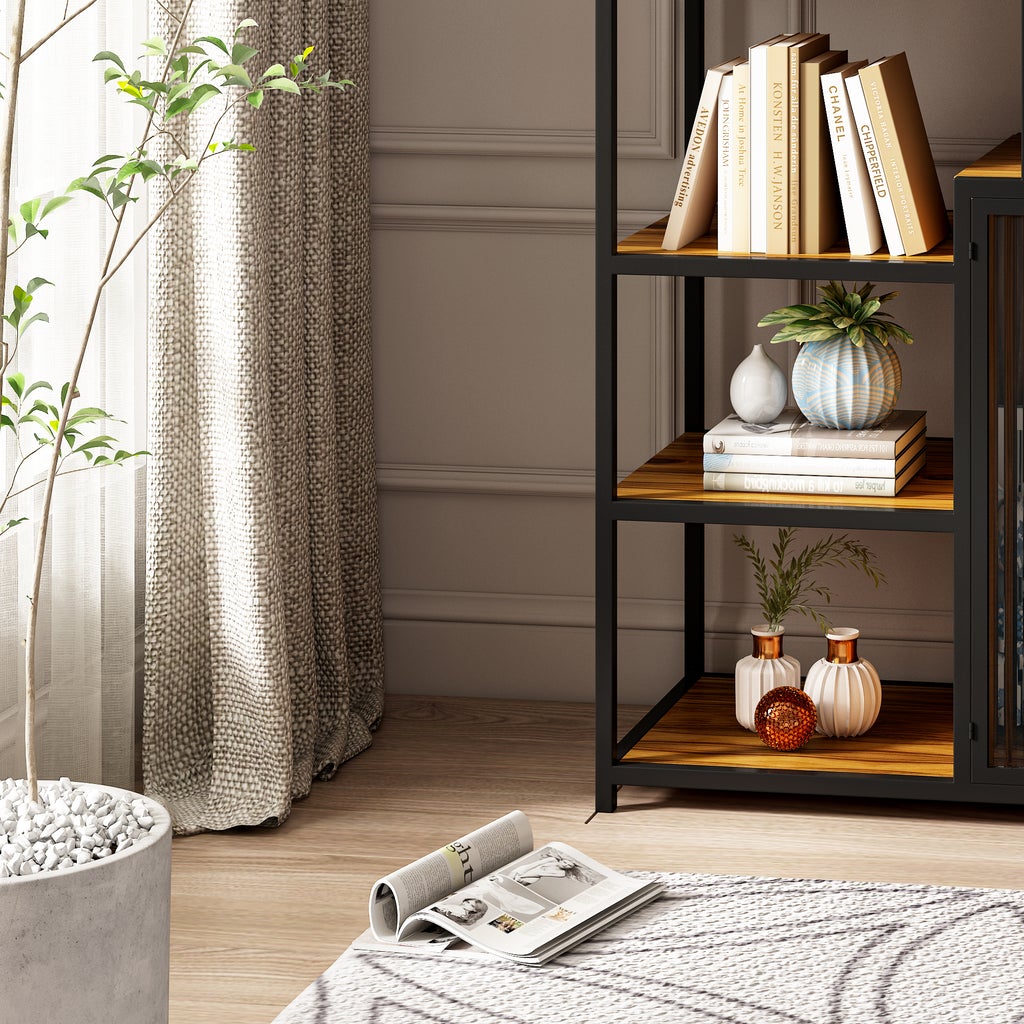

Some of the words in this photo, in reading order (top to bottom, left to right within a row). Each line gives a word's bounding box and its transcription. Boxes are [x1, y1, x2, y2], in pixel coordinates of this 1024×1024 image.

[738, 85, 746, 94] At
[738, 97, 746, 122] Home
[773, 82, 782, 141] KONSTEN
[828, 85, 846, 142] CHANEL
[691, 106, 709, 153] AVEDON
[737, 136, 746, 165] Joshua
[674, 154, 696, 208] advertising
[738, 168, 746, 187] Tree
[860, 124, 887, 198] CHIPPERFIELD
[870, 81, 884, 120] VICTORIA
[879, 122, 892, 149] HAGAN
[890, 157, 904, 193] INTERIOR
[899, 194, 914, 235] PORTRAITS
